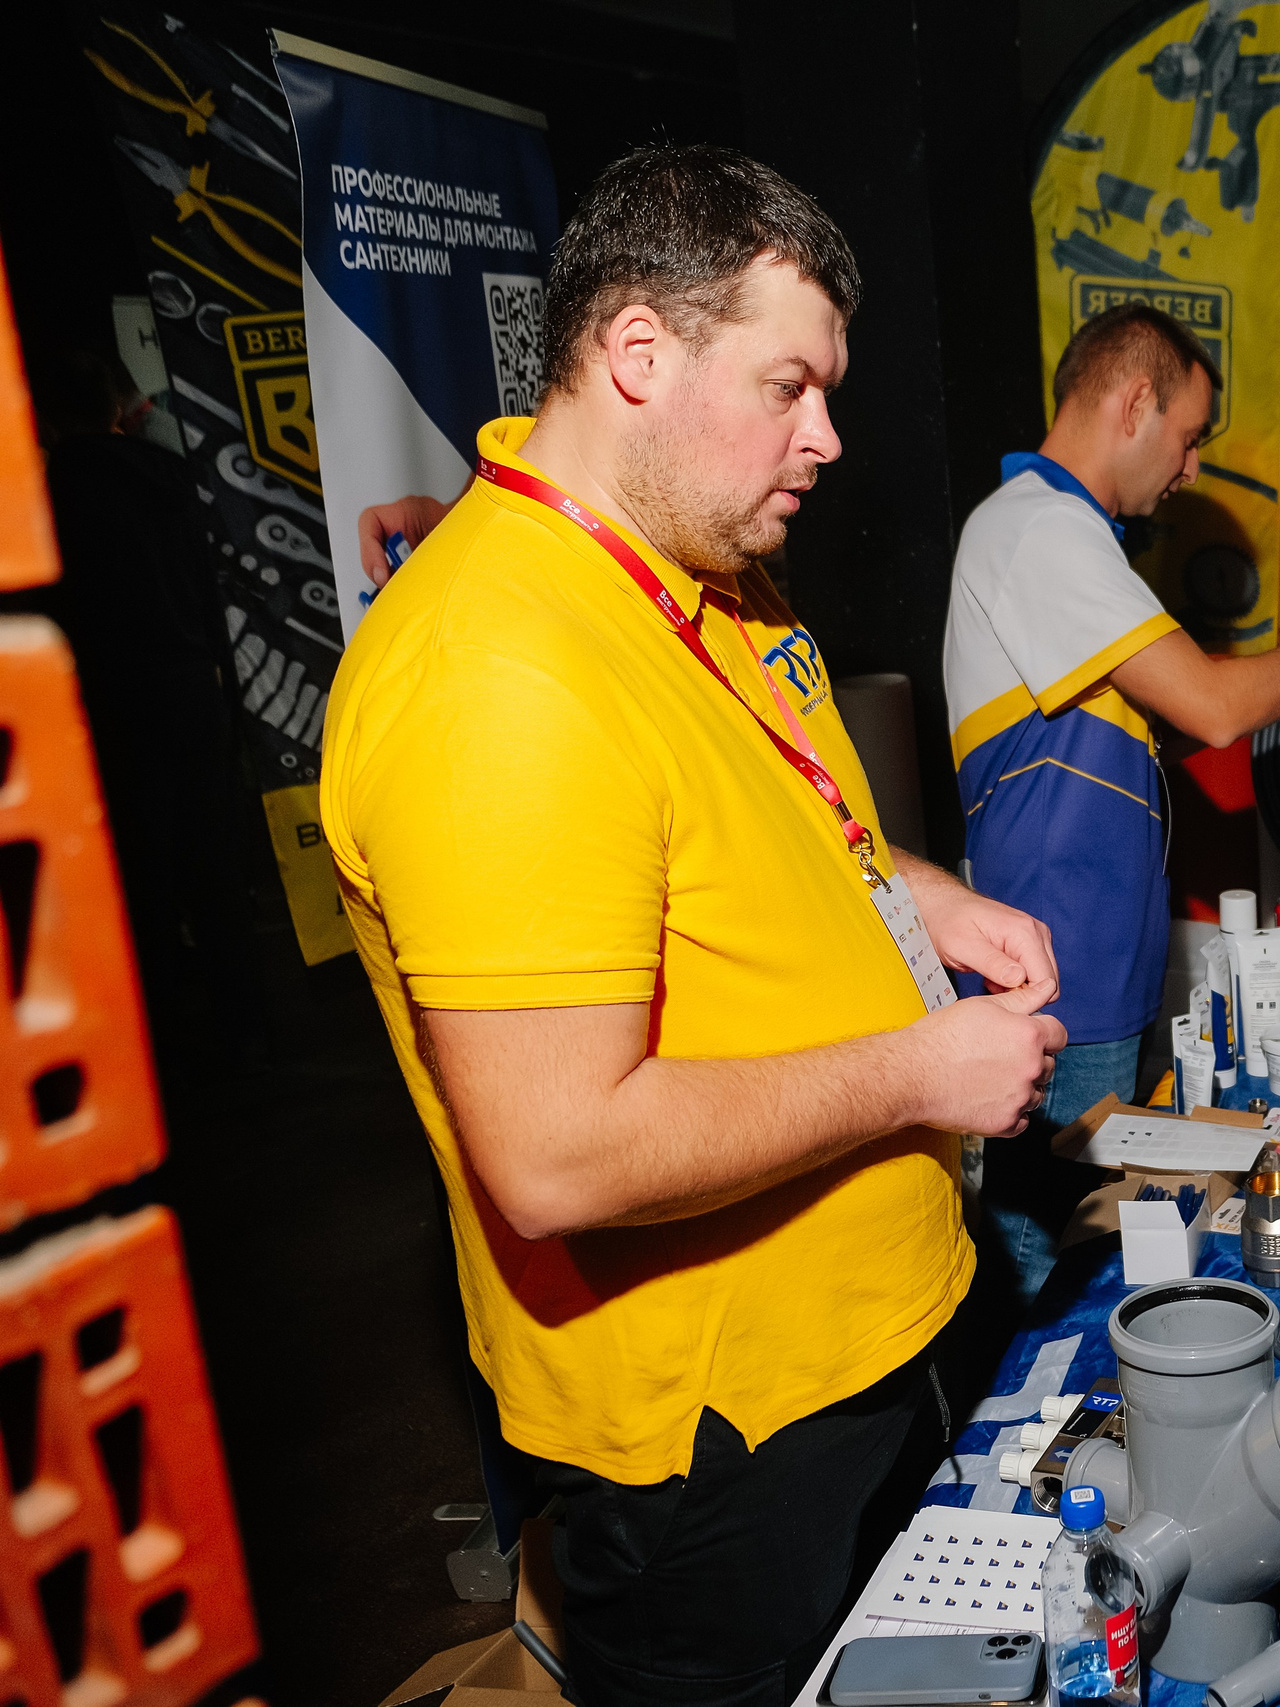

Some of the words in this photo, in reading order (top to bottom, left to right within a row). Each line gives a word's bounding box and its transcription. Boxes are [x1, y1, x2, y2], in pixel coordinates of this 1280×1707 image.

[331, 163, 502, 219] ПРОФЕССИОНАЛЬНЫЕ
[334, 202, 441, 242] МАТЕРИАЛЫ
[444, 217, 473, 249] ДЛЯ
[474, 222, 537, 253] МОНТАЖА
[339, 239, 452, 276] САНТЕХНИКИ
[243, 326, 307, 354] BER
[563, 499, 581, 515] Все
[659, 590, 673, 608] Все
[812, 775, 825, 790] Все
[1092, 1395, 1119, 1407] RTP
[1111, 1622, 1130, 1641] ИЩУ
[1118, 1635, 1130, 1648] ПО
